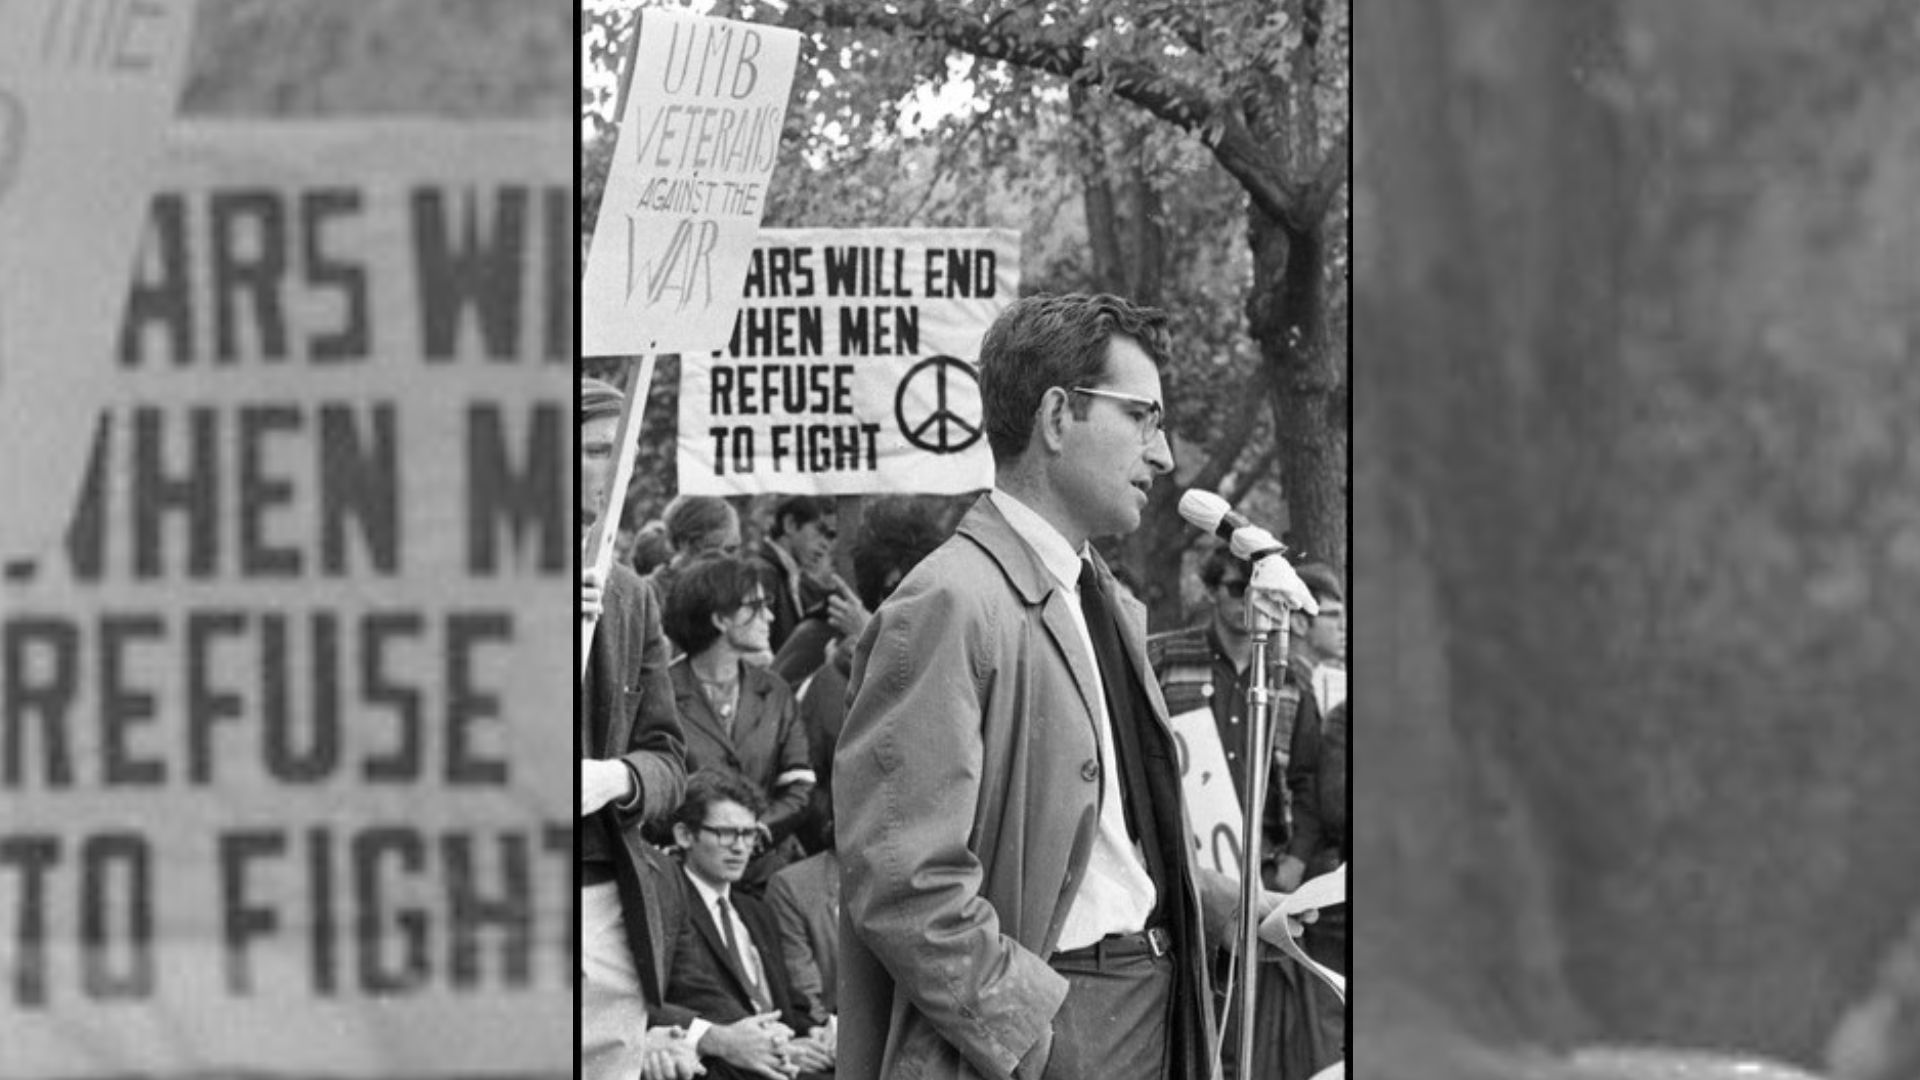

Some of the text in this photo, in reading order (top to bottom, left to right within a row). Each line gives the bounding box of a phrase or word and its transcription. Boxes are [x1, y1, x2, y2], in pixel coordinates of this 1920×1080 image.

[664, 22, 761, 100] UMB
[637, 102, 780, 174] VETERANS
[637, 177, 760, 216] AGAINST THE
[115, 189, 370, 366] ARS
[625, 212, 719, 312] WAR
[742, 246, 997, 299] ARS WILL END
[839, 305, 920, 356] MEN
[709, 364, 855, 416] REFUSE
[709, 422, 881, 476] TO FIGHT
[0, 612, 515, 786] REFUSE
[0, 832, 153, 1008] TO
